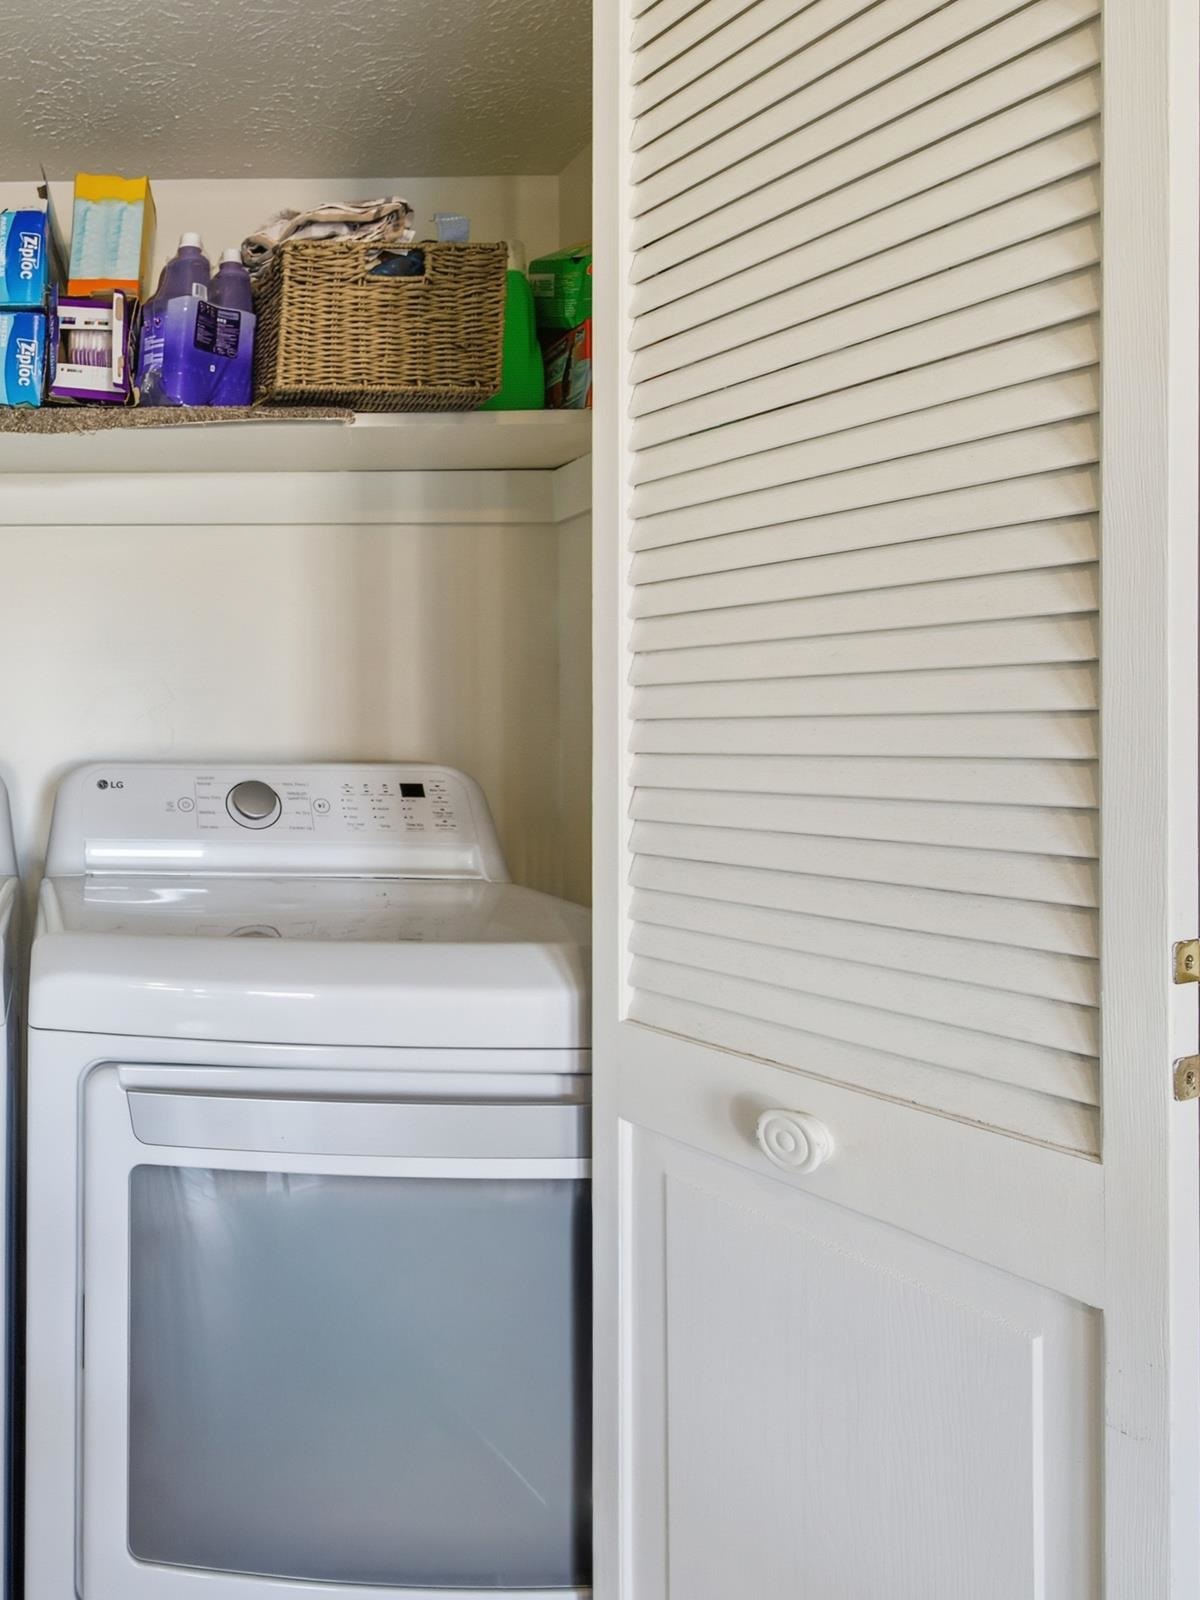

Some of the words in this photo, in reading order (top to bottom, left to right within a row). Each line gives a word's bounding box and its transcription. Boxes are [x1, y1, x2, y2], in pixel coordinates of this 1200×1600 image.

[19, 234, 40, 280] Ziploc
[17, 340, 37, 387] Ziploc
[110, 781, 124, 789] LG
